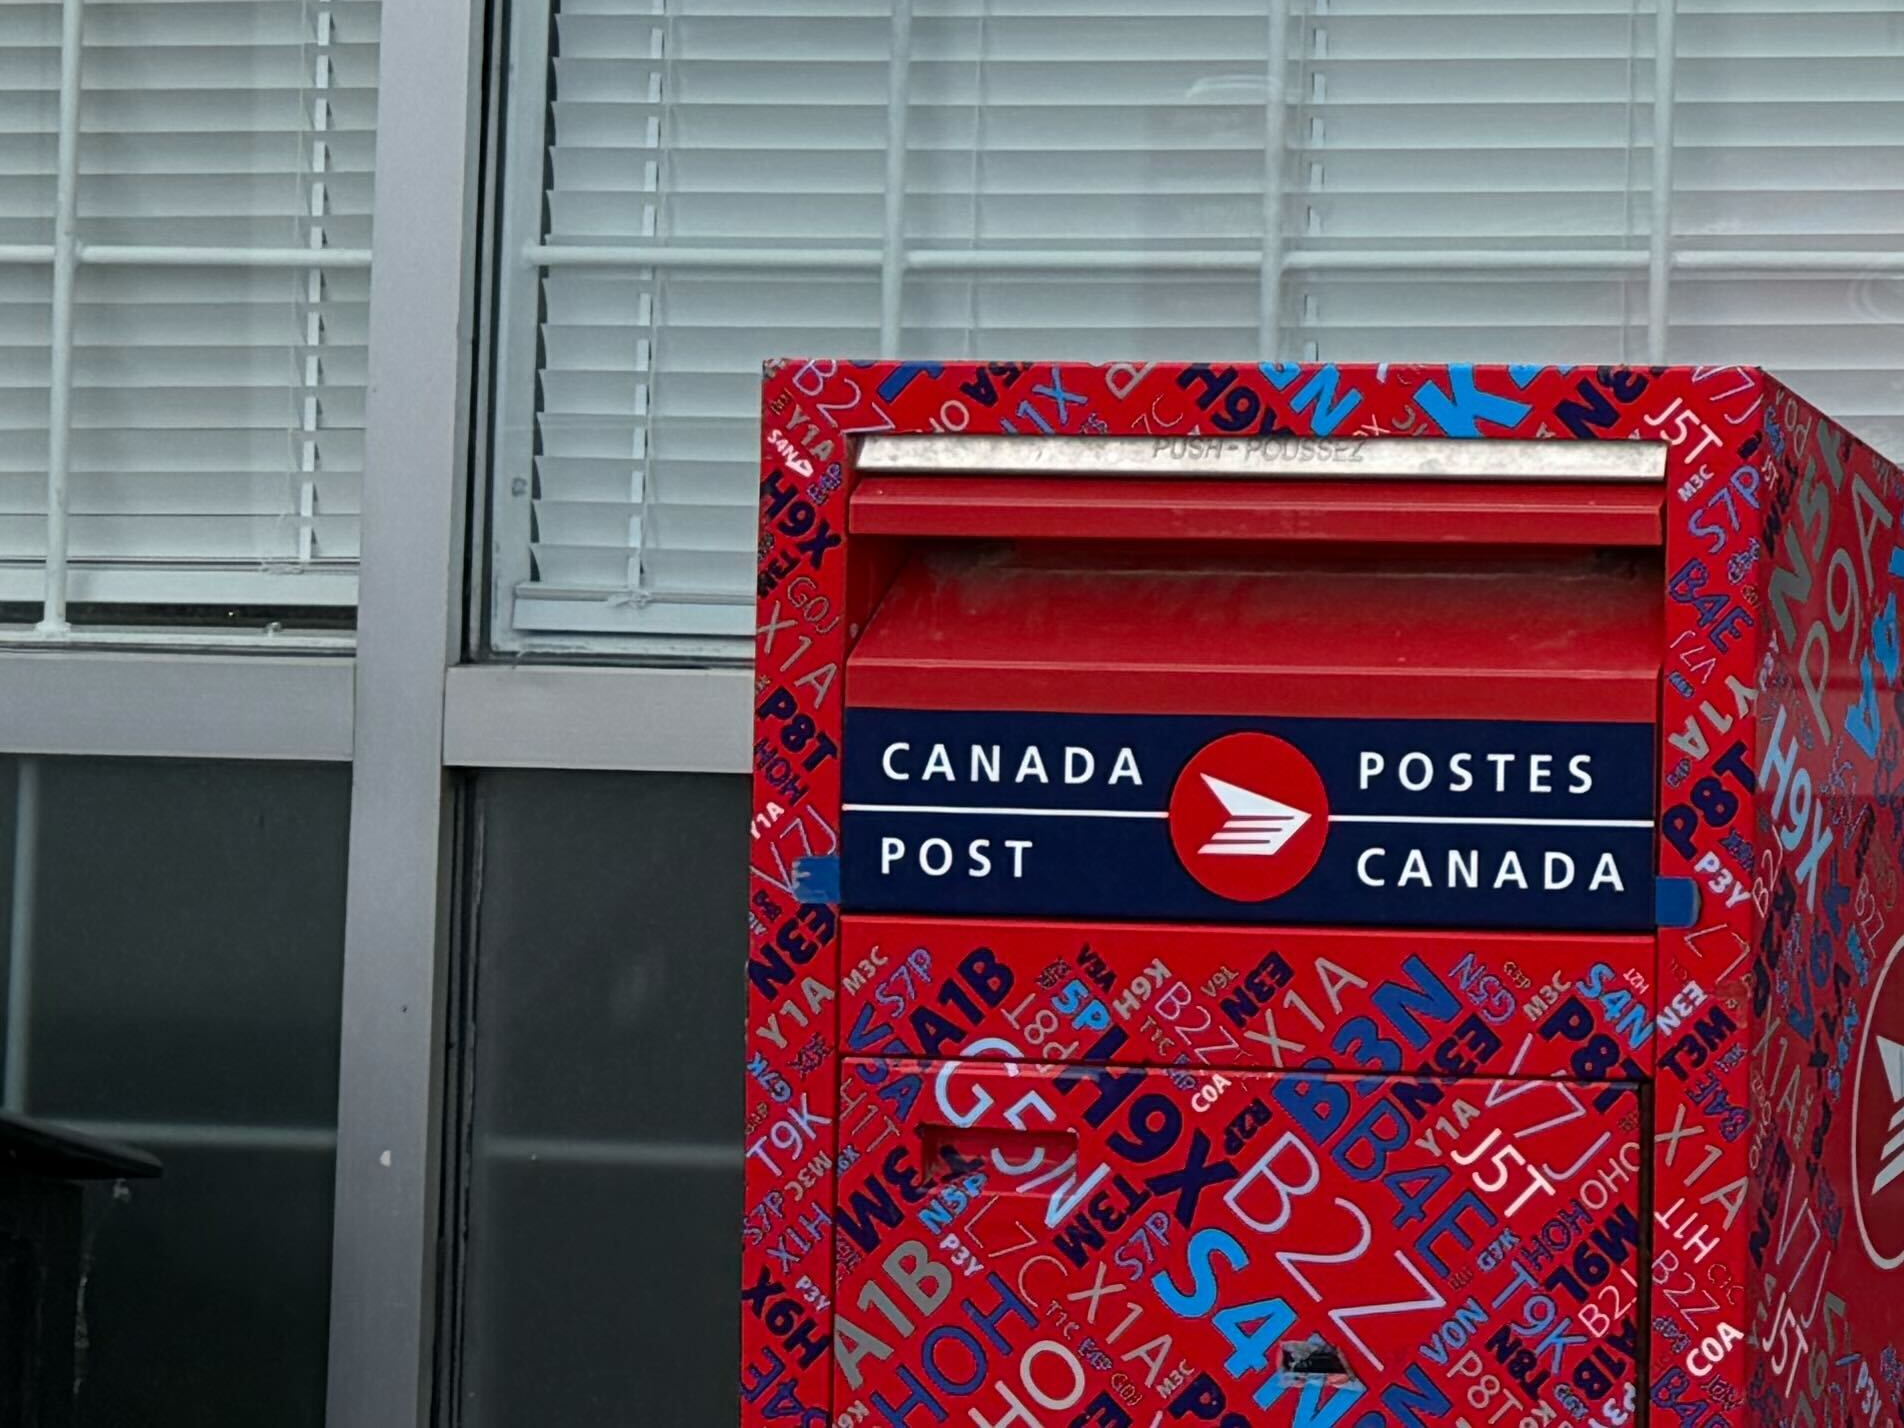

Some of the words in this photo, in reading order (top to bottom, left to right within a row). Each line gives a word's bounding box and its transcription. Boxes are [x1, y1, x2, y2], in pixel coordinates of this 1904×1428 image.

[1152, 437, 1223, 461] PUSH
[1245, 439, 1368, 464] POUSSEZ
[1643, 397, 1724, 464] J5T
[760, 471, 841, 569] H9X
[1676, 464, 1715, 502] M3C
[1687, 464, 1760, 554] S7P
[1667, 556, 1754, 654] B4E
[1799, 472, 1893, 745] P9A
[756, 601, 839, 708] X1A
[755, 686, 838, 772] P8T
[1667, 674, 1757, 761] Y1A
[882, 742, 1143, 788] CANADA
[1358, 752, 1594, 795] POSTES
[1662, 740, 1755, 861] P8T
[1758, 704, 1833, 914] H9X
[881, 836, 1033, 879] POST
[1357, 847, 1625, 892] CANADA
[1694, 850, 1751, 909] P3Y
[1855, 873, 1884, 959] B2Z
[756, 975, 834, 1048] Y1A
[842, 945, 888, 996] M3C
[875, 948, 932, 1018] S7P
[908, 946, 1015, 1069] A1B
[1112, 957, 1173, 1021] K6H
[1219, 950, 1295, 1028] E3N
[1243, 956, 1369, 1068] X1A
[1522, 969, 1573, 1022] M3C
[1576, 961, 1656, 1050] S4N
[1656, 980, 1708, 1036] E3N
[1154, 980, 1240, 1066] B2Z
[1271, 953, 1463, 1145] B3N
[1390, 1012, 1503, 1121] E3N
[1658, 1006, 1737, 1081] T3M
[1485, 1032, 1611, 1182] V7J
[1754, 997, 1800, 1138] X1A
[745, 1092, 832, 1178] T9K
[1052, 1024, 1240, 1230] H9X
[1415, 1098, 1481, 1158] Y1A
[1654, 1103, 1749, 1231] X1A
[784, 1149, 832, 1202] M3C
[1330, 1098, 1498, 1279] B4E
[1450, 1128, 1556, 1219] J5T
[766, 1201, 832, 1275] H1X
[939, 1233, 984, 1277] P3Y
[964, 1194, 1068, 1310] L7C
[1053, 1174, 1150, 1270] T3M
[1113, 1211, 1171, 1282] S7P
[1223, 1131, 1446, 1372] B2Z
[1545, 1203, 1640, 1301] M9L
[1654, 1197, 1720, 1264] H1T
[1775, 1163, 1831, 1329] V7J
[742, 1264, 830, 1370] H9X
[795, 1275, 832, 1312] P3Y
[834, 1239, 953, 1391] A1B
[1066, 1261, 1174, 1389] X1A
[1492, 1260, 1588, 1376] T9K
[1651, 1249, 1721, 1331] B2Z
[1155, 1359, 1196, 1400] M3C
[1447, 1350, 1524, 1425] P8T
[1763, 1292, 1808, 1397] J5T
